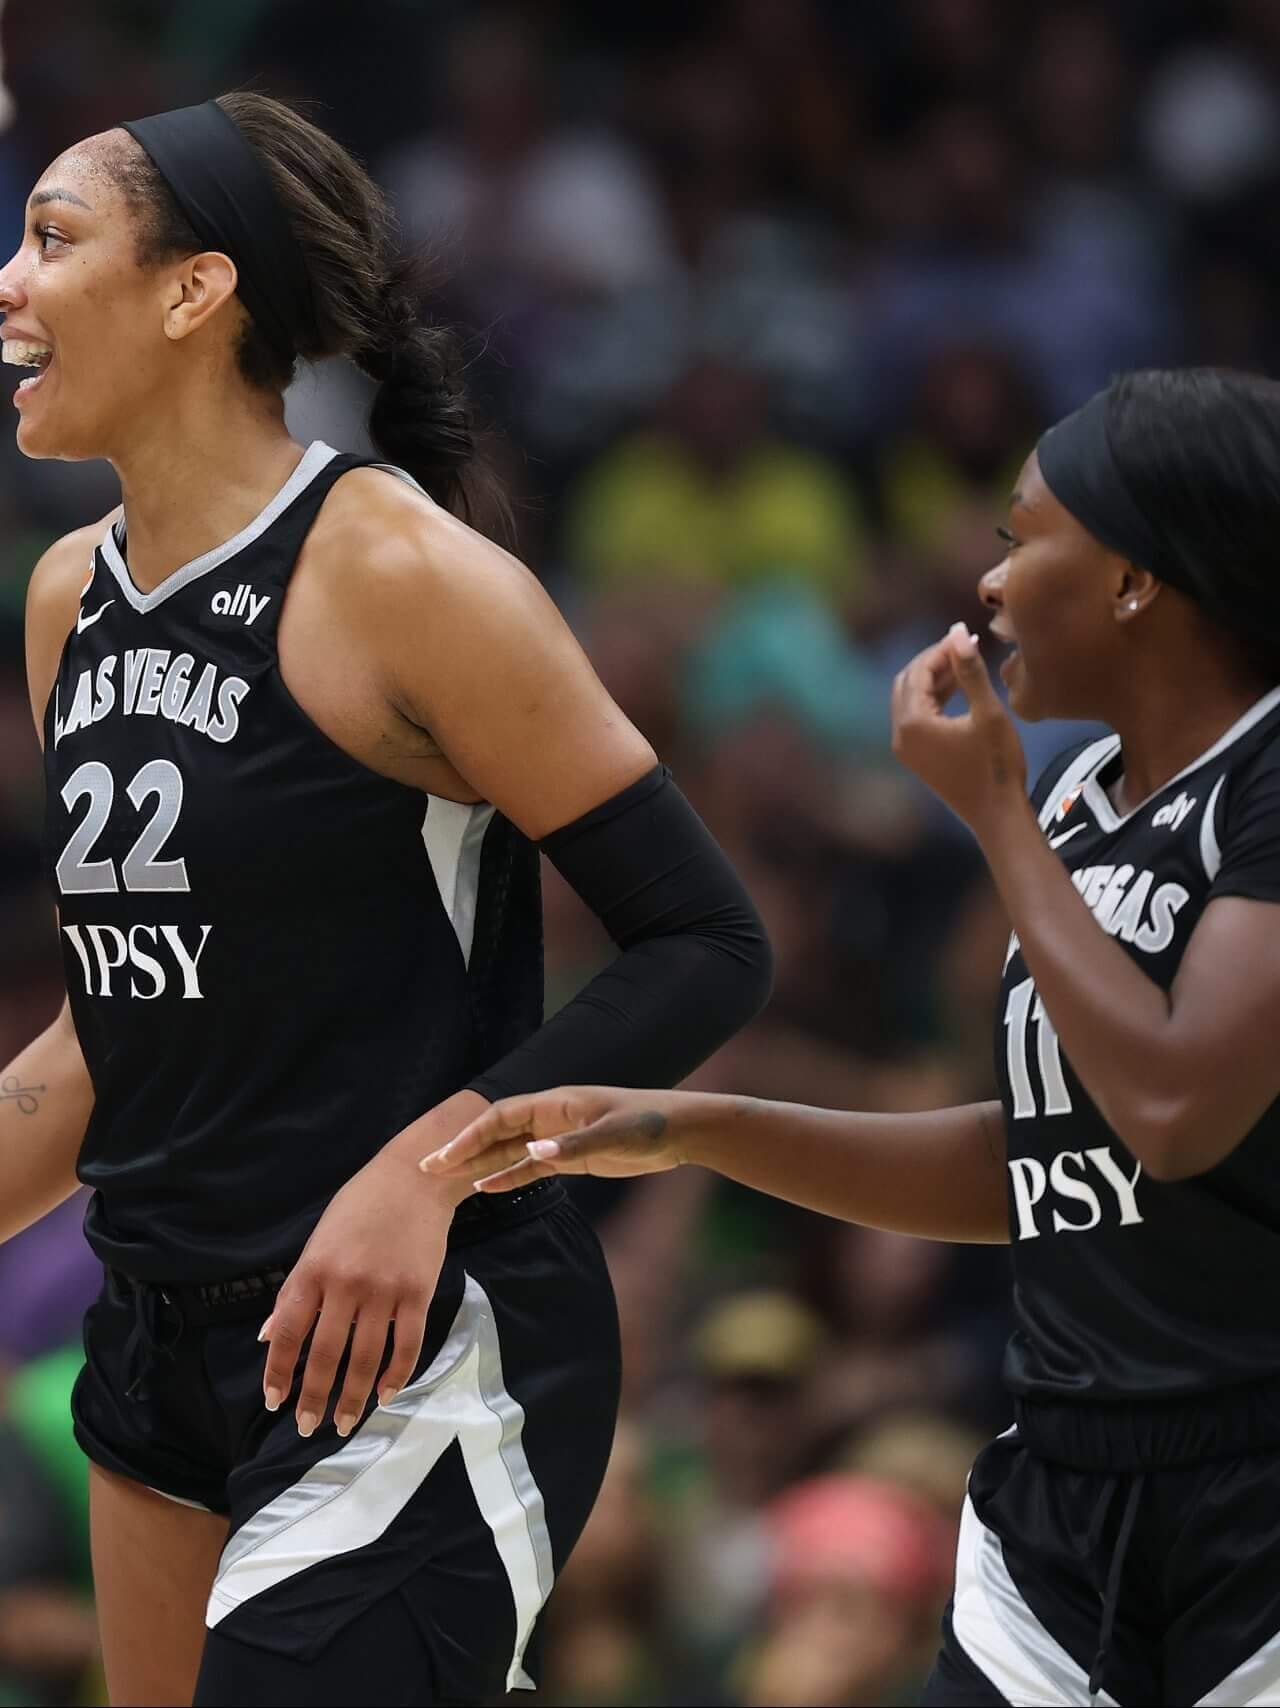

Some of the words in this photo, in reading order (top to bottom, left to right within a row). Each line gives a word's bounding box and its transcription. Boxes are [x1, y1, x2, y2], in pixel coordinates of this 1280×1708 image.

[210, 584, 271, 625] ally
[123, 648, 250, 743] VEGAS
[55, 759, 191, 895] 22
[61, 924, 213, 1000] IPSY
[1003, 976, 1072, 1120] 11
[1007, 1146, 1144, 1241] PSY
